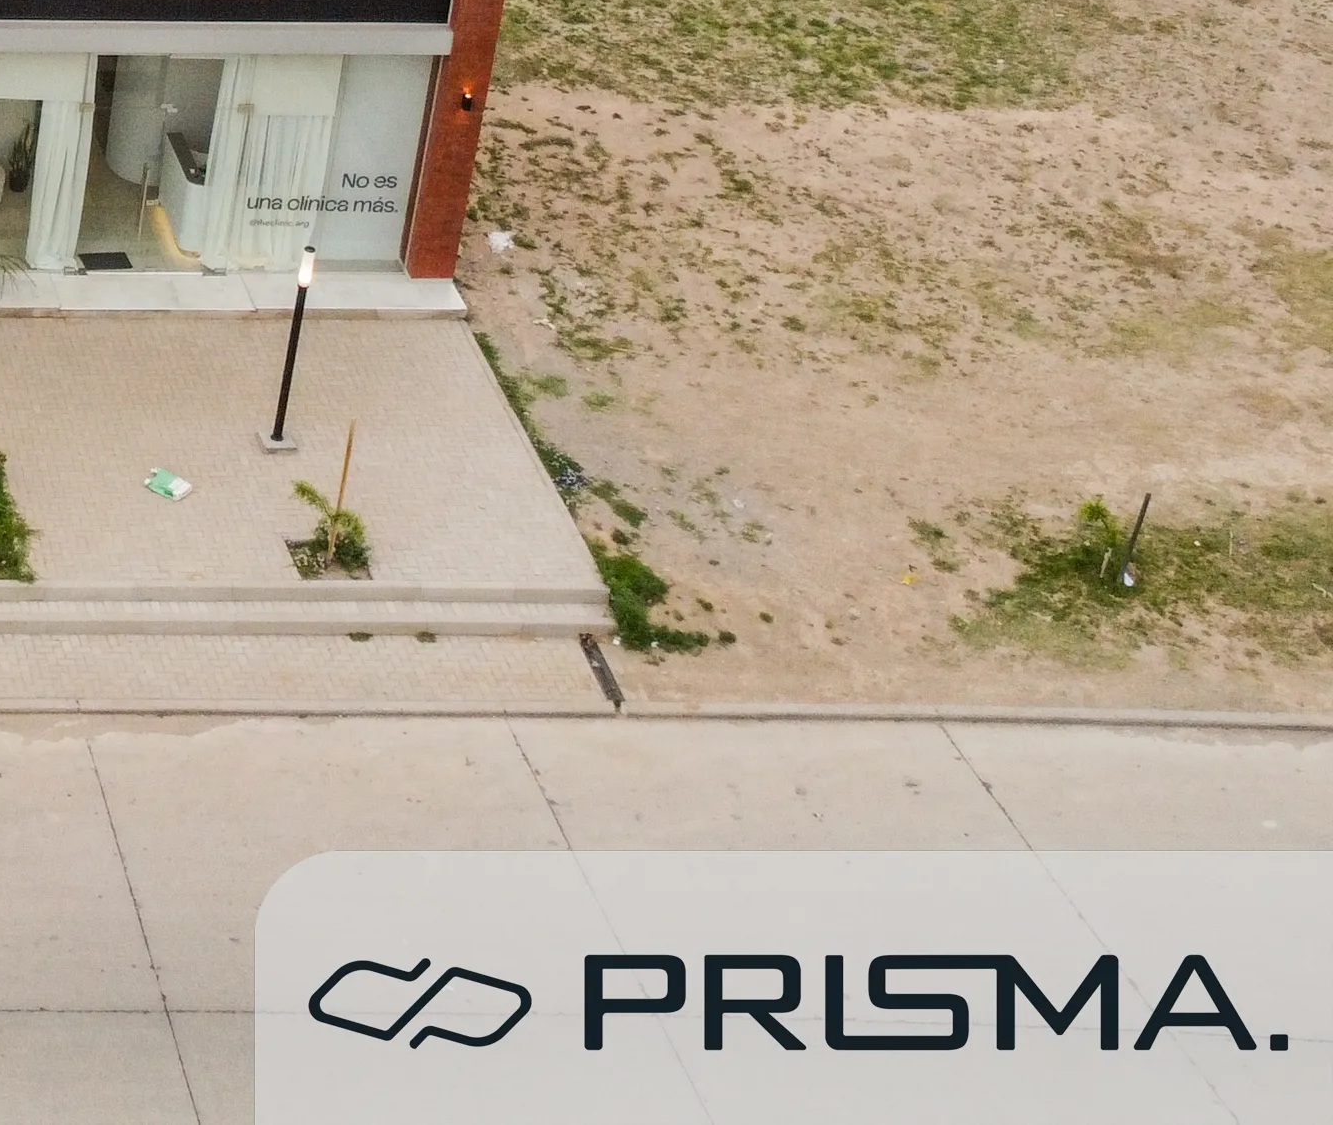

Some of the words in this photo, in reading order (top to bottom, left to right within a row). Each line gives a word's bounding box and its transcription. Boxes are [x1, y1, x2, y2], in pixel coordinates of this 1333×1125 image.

[341, 173, 370, 188] No
[373, 175, 398, 188] es
[246, 196, 283, 210] una
[352, 196, 399, 213] más.
